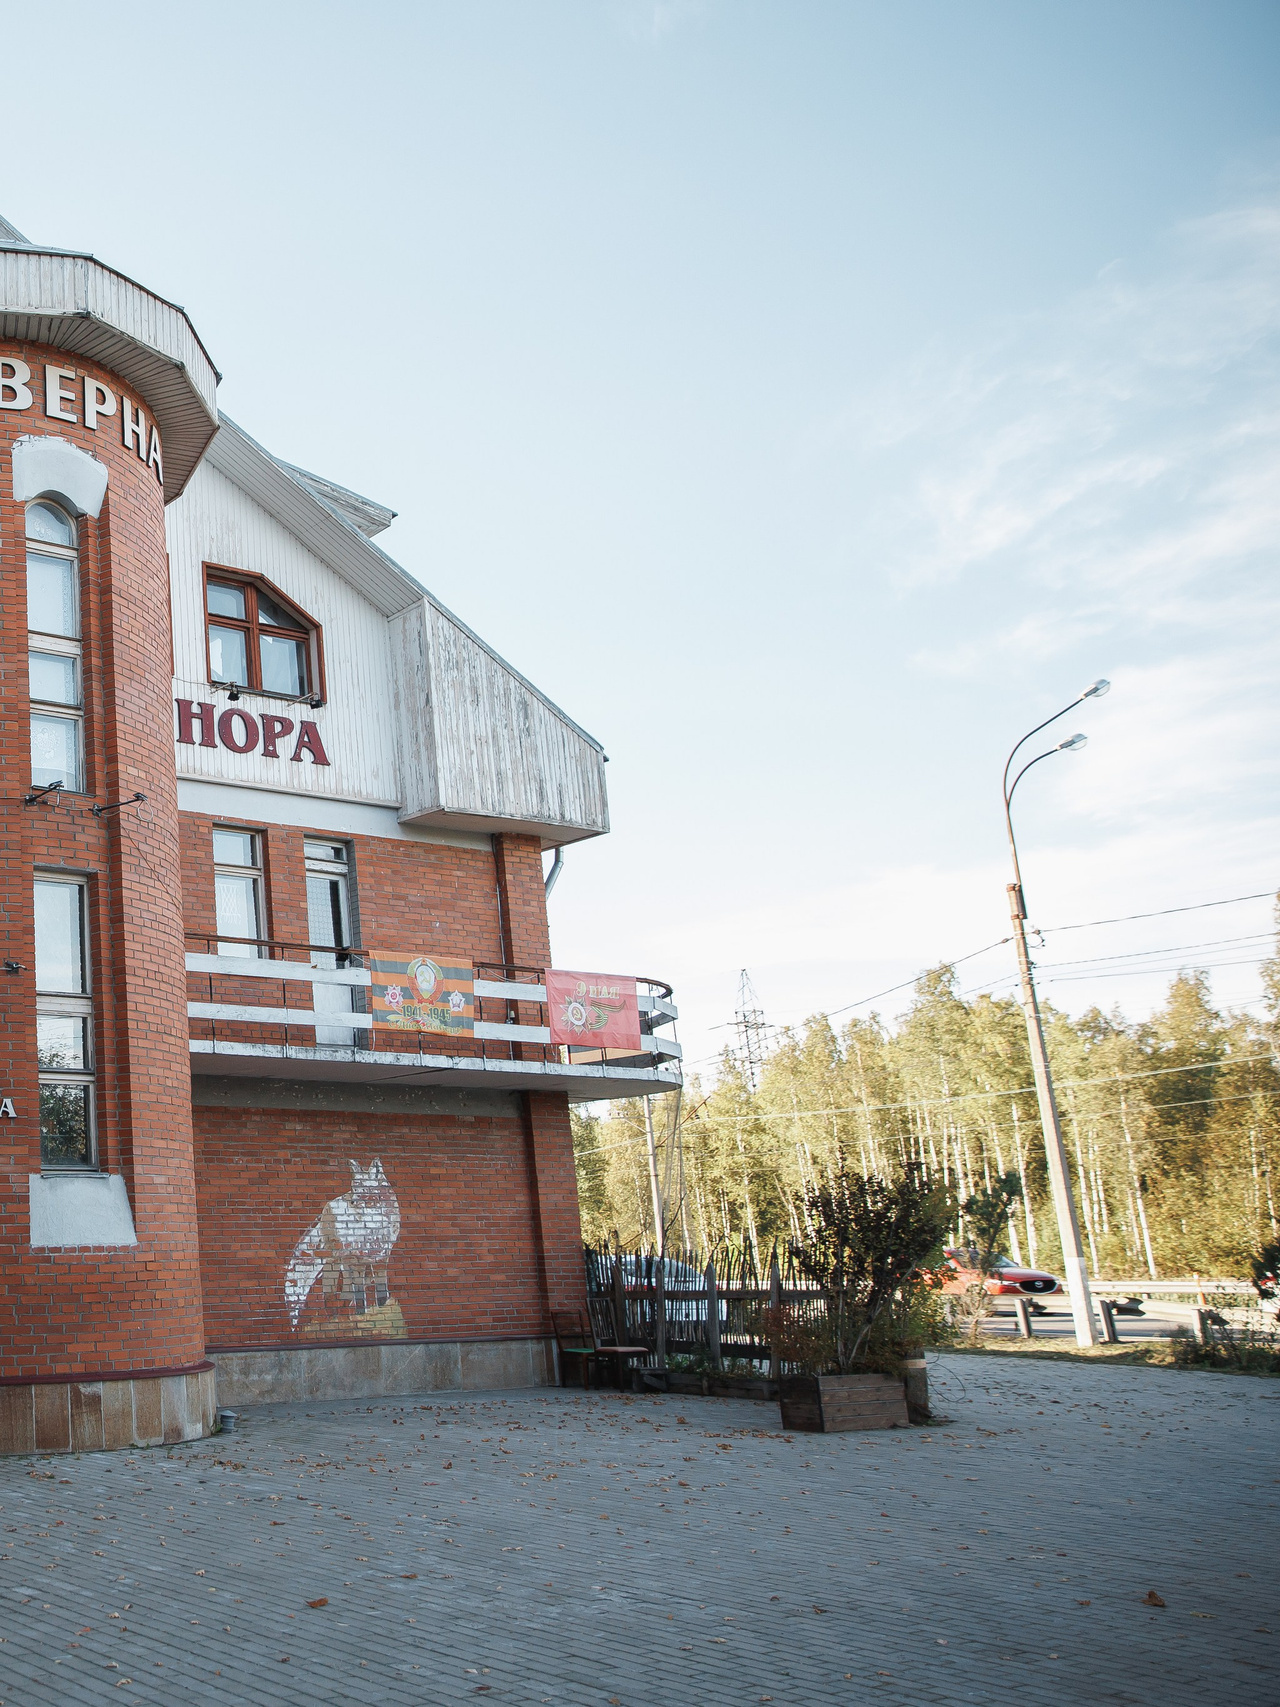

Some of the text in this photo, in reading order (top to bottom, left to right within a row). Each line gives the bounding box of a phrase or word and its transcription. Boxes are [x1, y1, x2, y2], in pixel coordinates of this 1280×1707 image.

[174, 698, 331, 766] НОРА
[576, 981, 620, 999] 9 МАЯ
[401, 1004, 421, 1018] 1941
[428, 1007, 451, 1021] 1945
